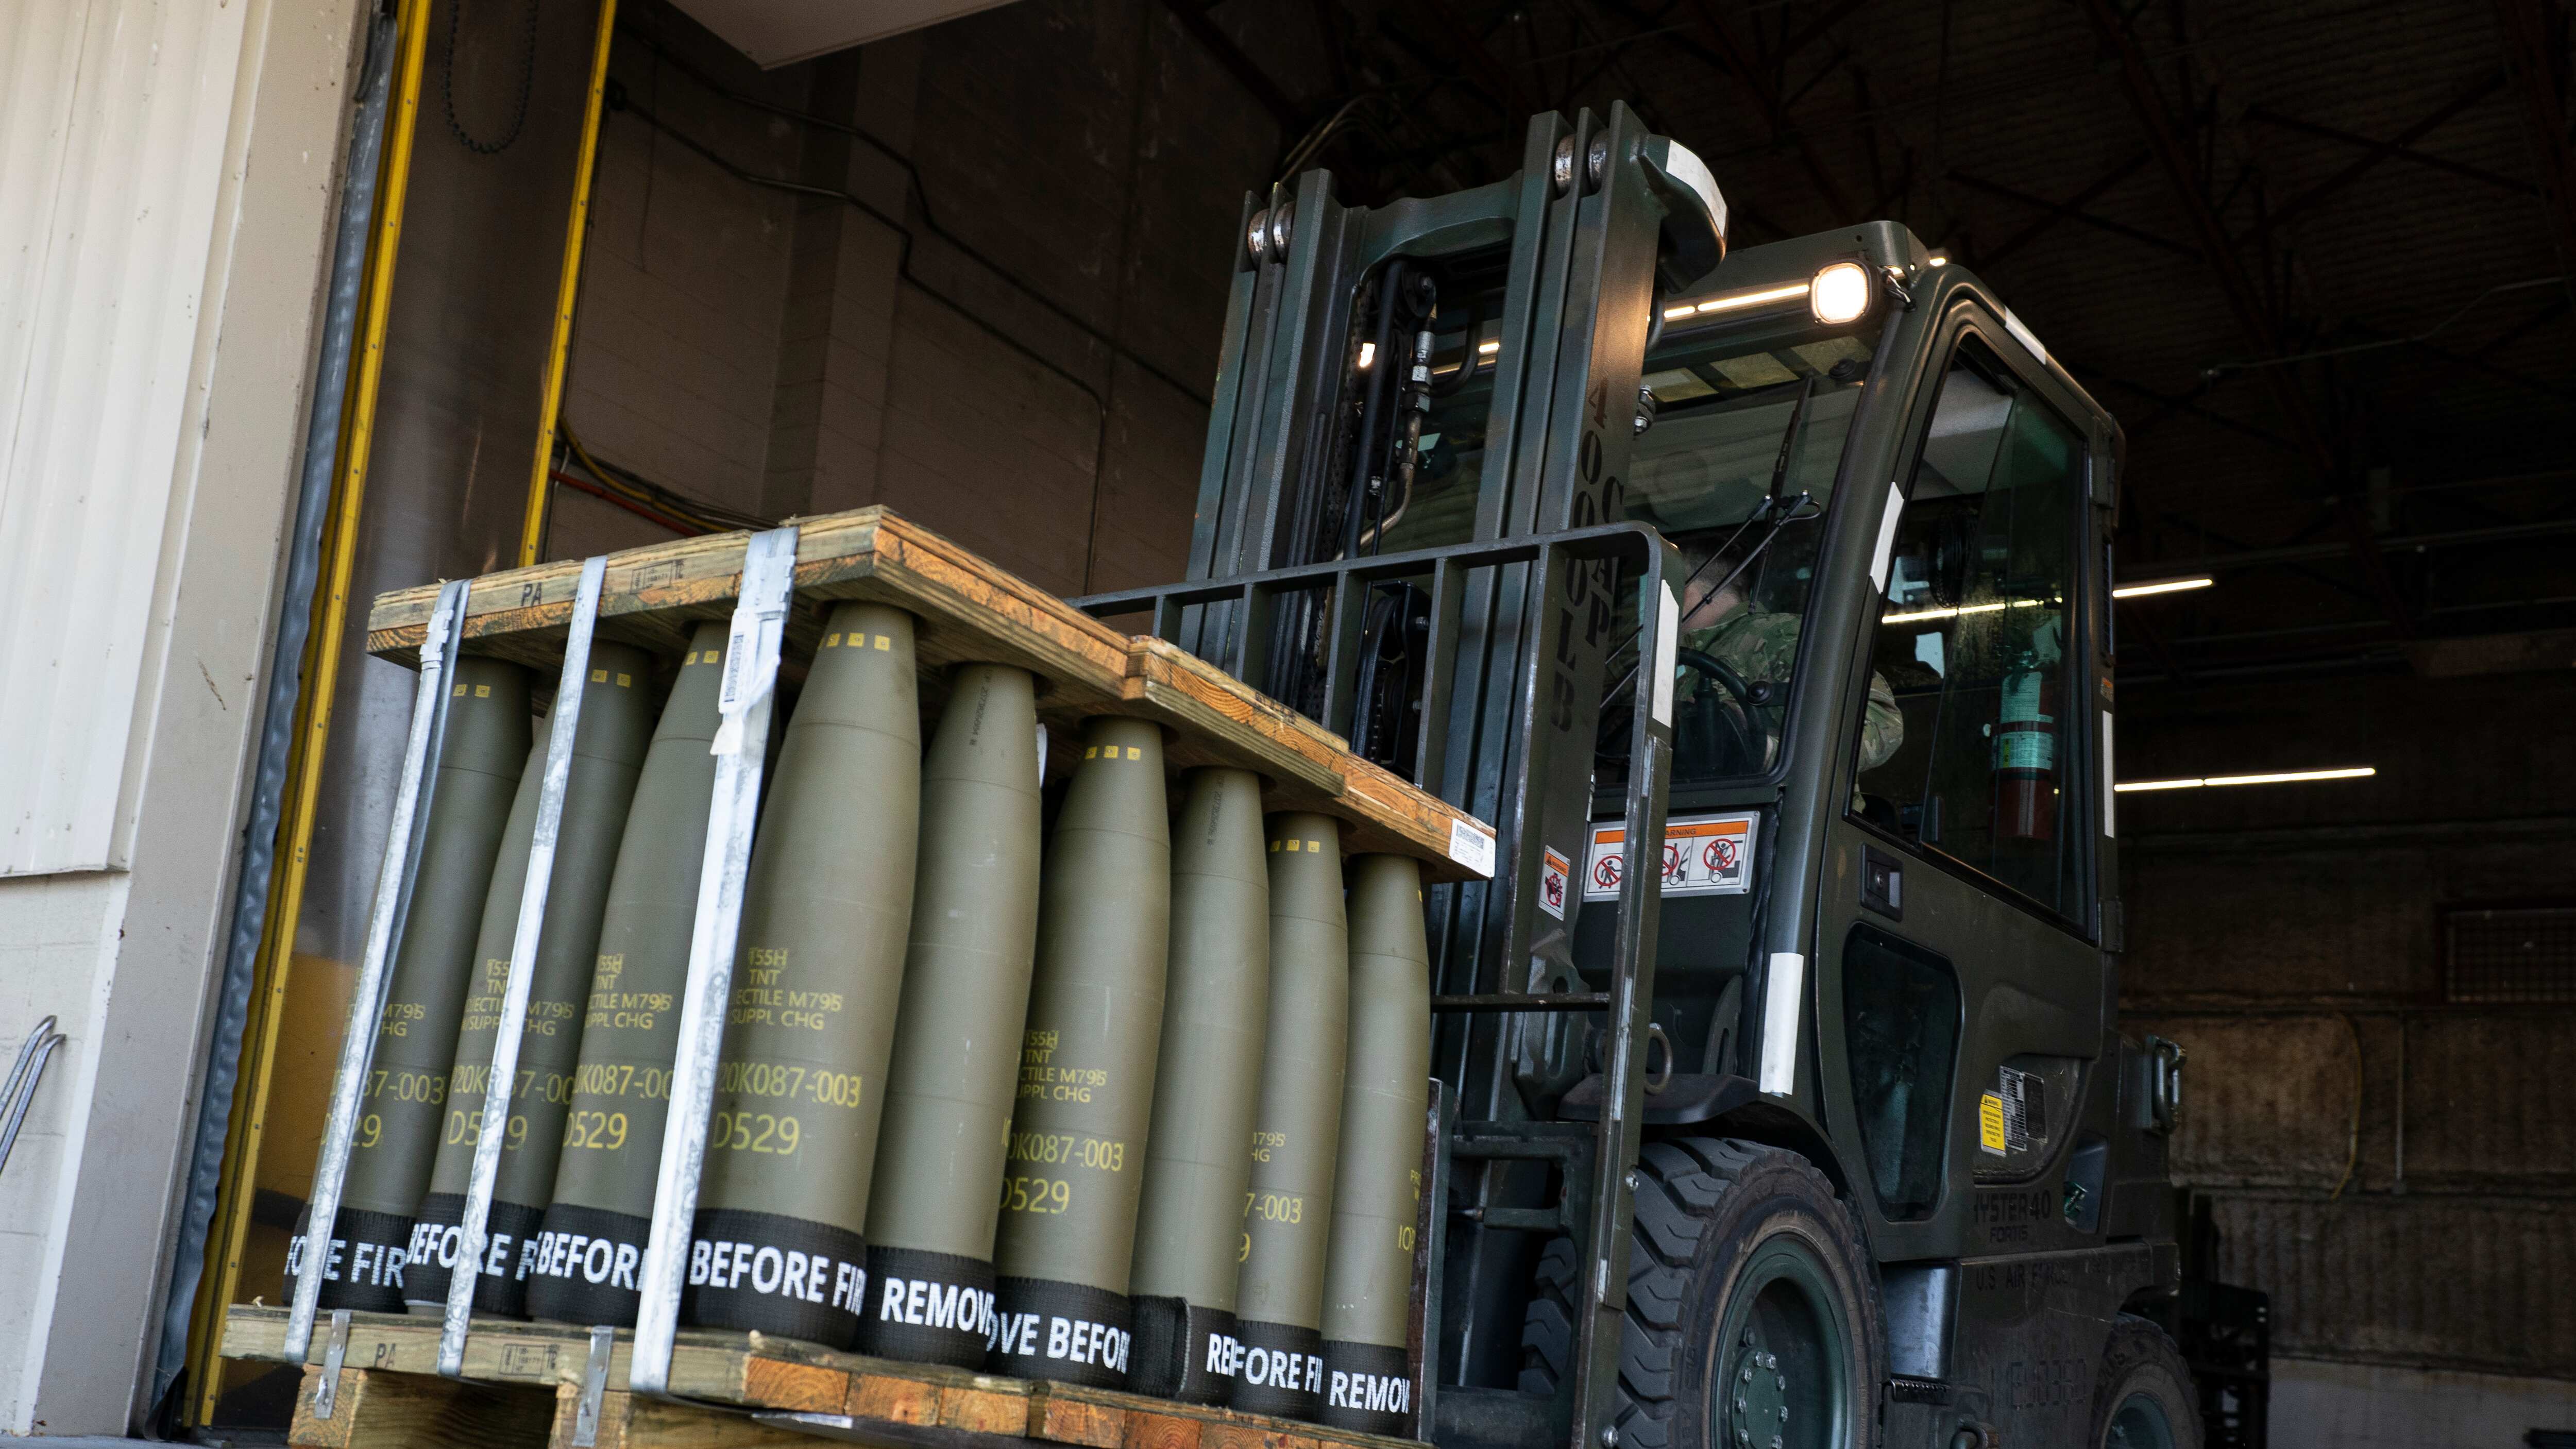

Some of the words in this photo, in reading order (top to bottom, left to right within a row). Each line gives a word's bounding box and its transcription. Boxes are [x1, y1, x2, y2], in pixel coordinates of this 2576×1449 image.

[520, 582, 542, 606] PA
[486, 980, 507, 995] TN
[381, 1021, 408, 1037] HG
[526, 1018, 556, 1036] HG
[614, 1012, 653, 1030] CHG
[781, 1010, 825, 1031] CHG
[1053, 1085, 1092, 1103] CHG
[713, 1113, 800, 1155] D529
[350, 1242, 408, 1289] FIR
[688, 1239, 830, 1303] BEFORE
[2006, 1263, 2025, 1289] AIR
[374, 1342, 396, 1369] PA
